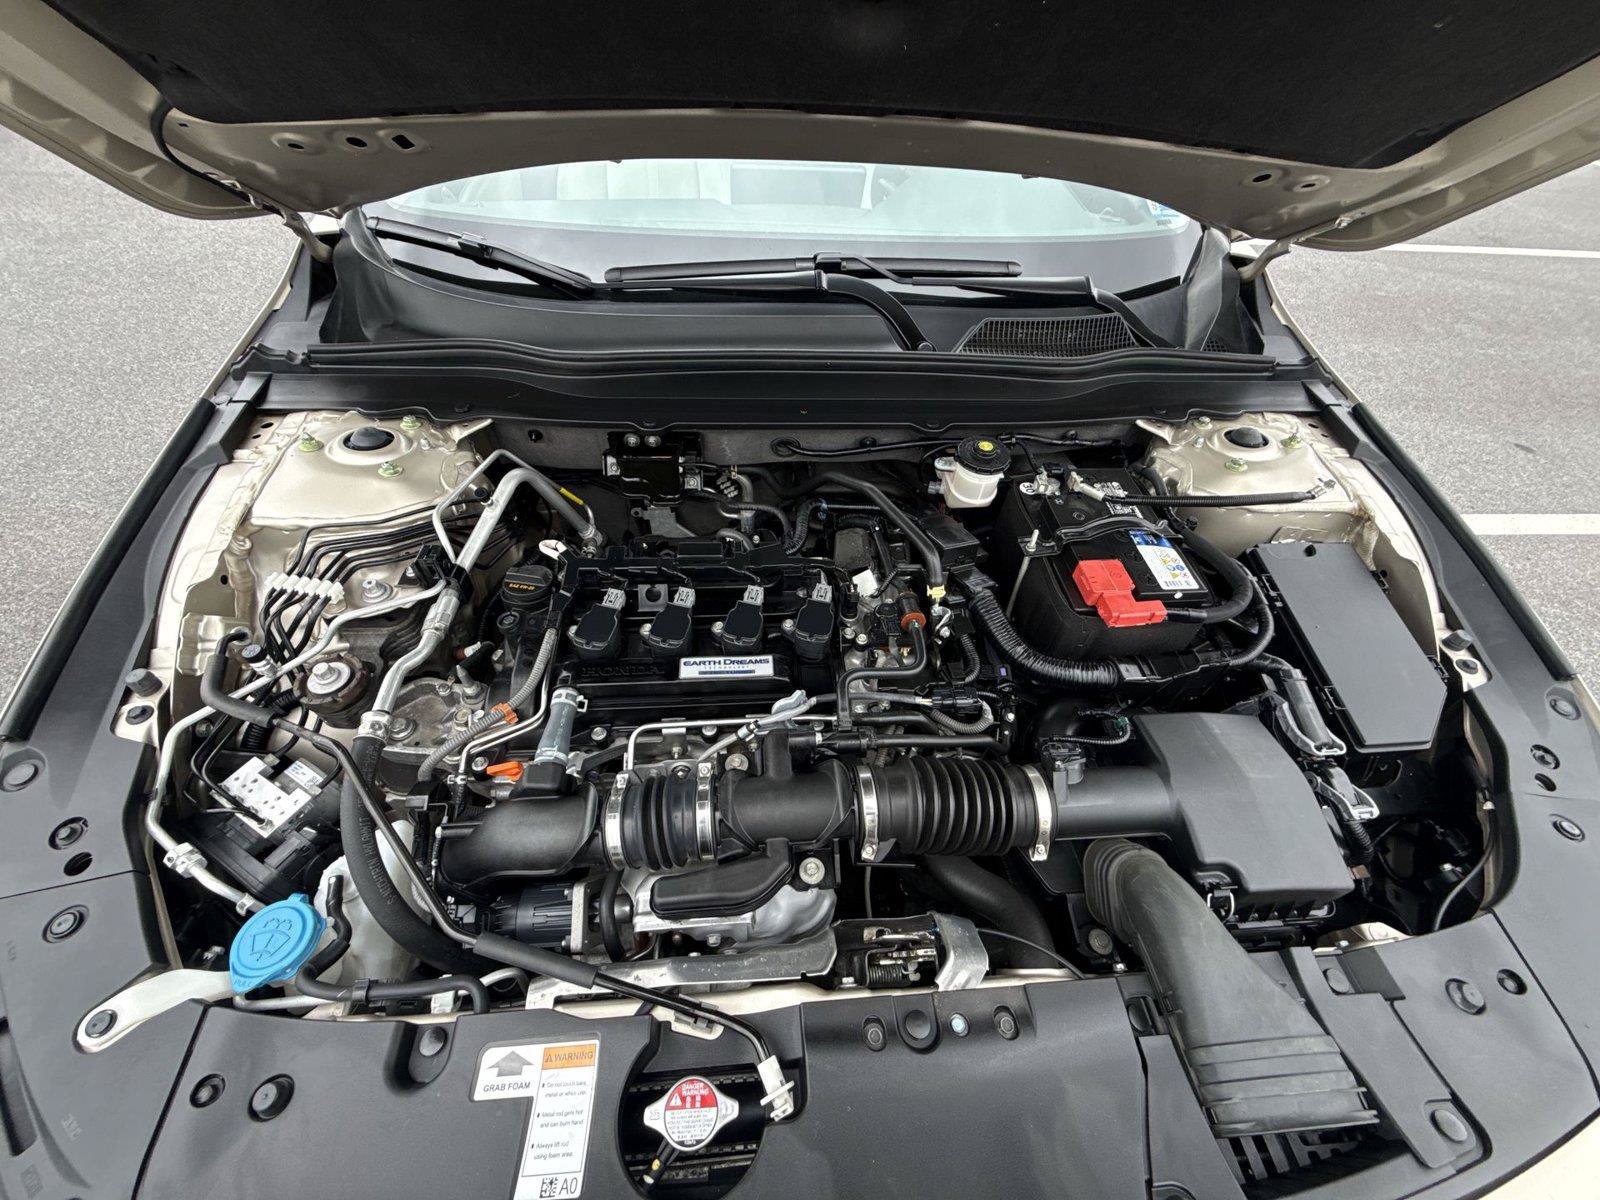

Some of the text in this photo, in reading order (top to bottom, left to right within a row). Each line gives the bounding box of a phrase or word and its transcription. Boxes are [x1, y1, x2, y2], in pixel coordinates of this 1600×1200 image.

[723, 658, 770, 666] DREAMS
[554, 1050, 594, 1062] WARNING
[483, 1081, 531, 1092] GRAB FOAM
